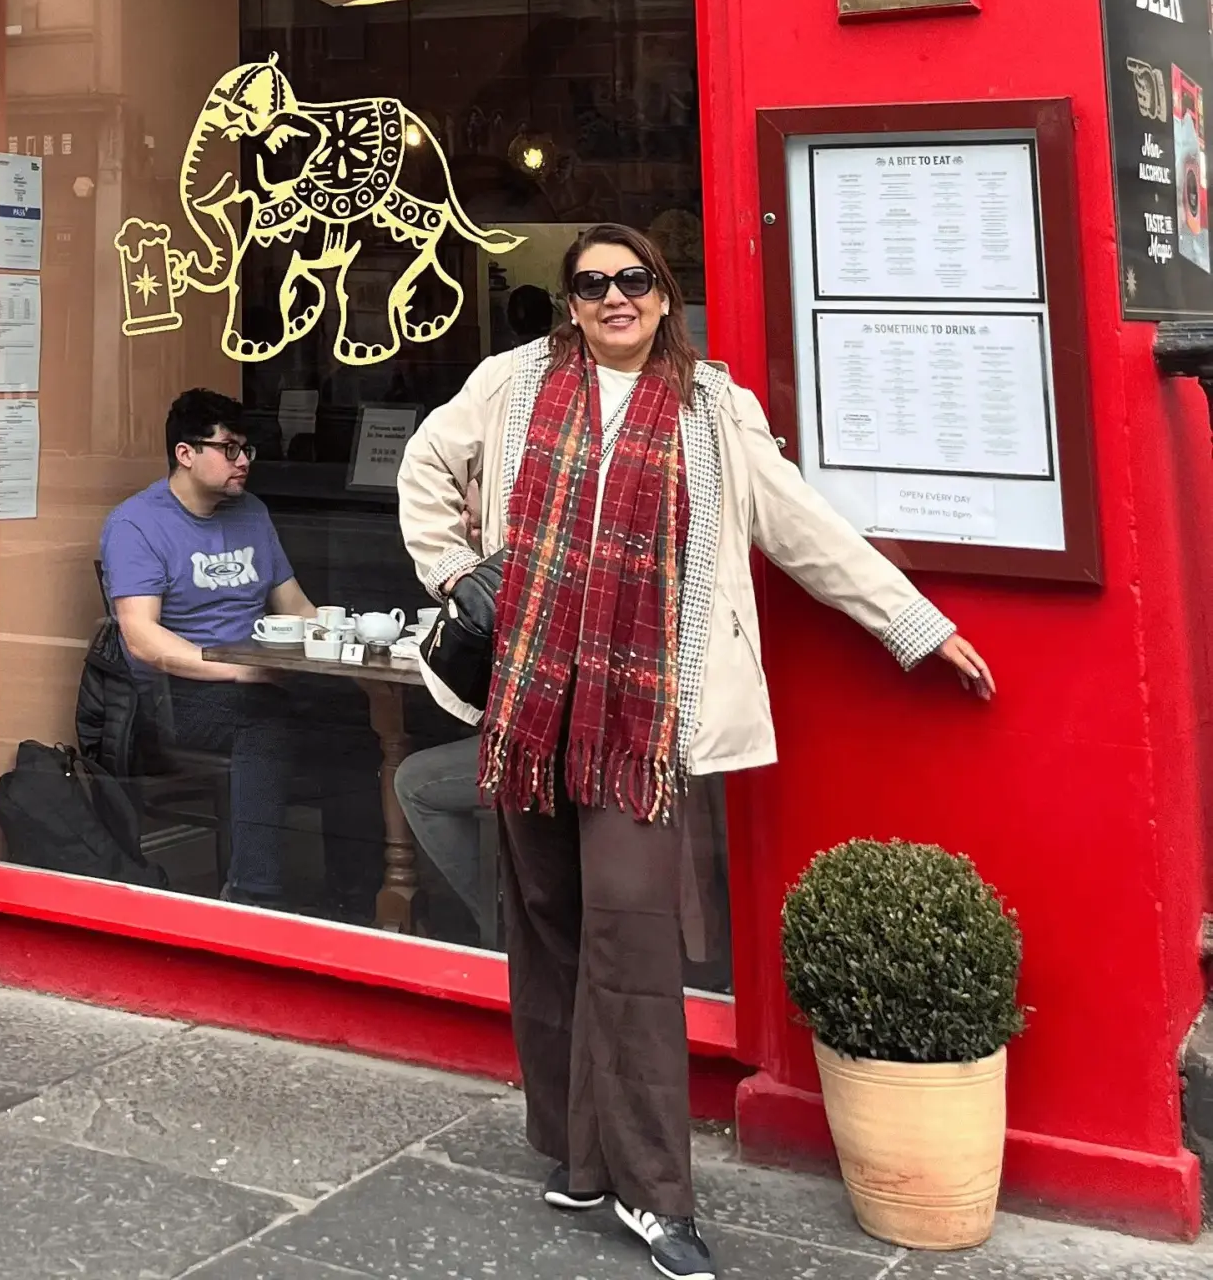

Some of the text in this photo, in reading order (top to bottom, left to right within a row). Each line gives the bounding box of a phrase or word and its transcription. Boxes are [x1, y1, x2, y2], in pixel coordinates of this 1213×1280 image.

[888, 155, 951, 166] A BITE TO EAT
[1139, 162, 1172, 185] ALCOHOLIC
[1144, 212, 1165, 234] TASTE
[874, 324, 977, 335] SOMETHING TO DRINK
[899, 489, 971, 504] OPEN EVERY DAY
[899, 505, 919, 515] from
[942, 509, 951, 517] to
[350, 646, 356, 656] 1
